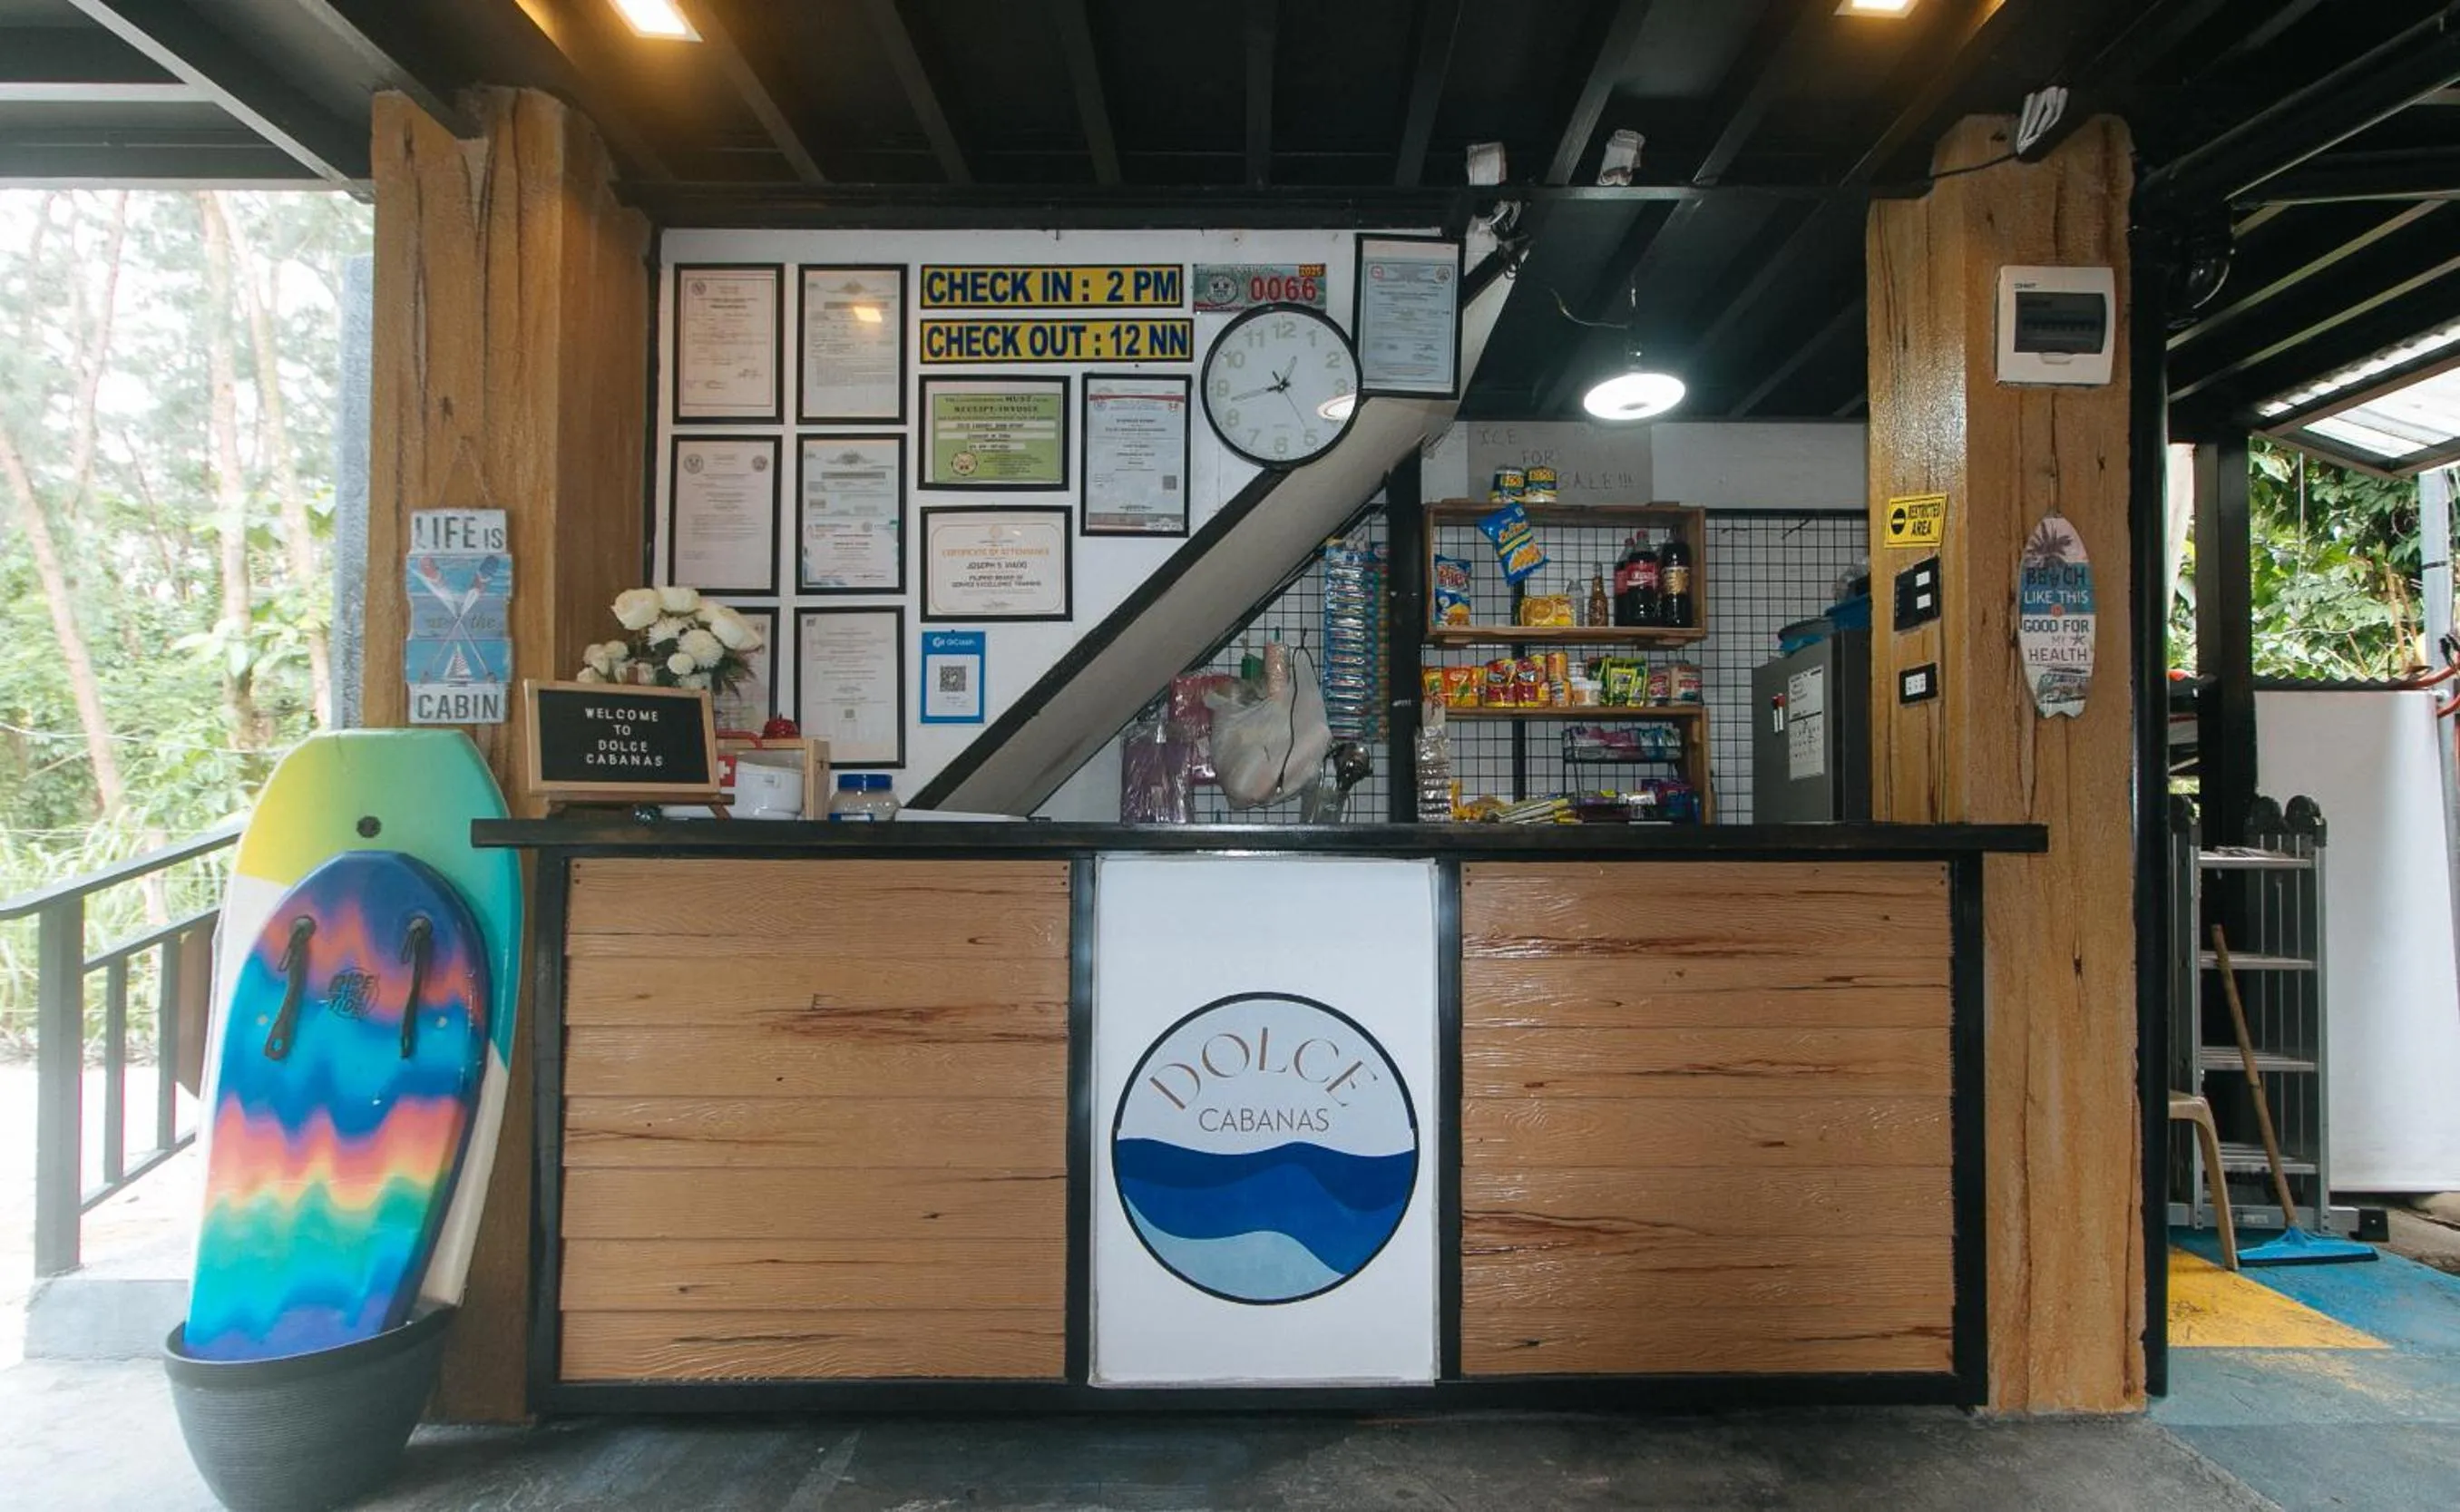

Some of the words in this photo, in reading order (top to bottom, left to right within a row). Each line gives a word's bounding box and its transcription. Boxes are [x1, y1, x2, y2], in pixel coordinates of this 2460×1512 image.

[927, 271, 1033, 303] CHECK
[1041, 271, 1072, 302] IN
[1107, 270, 1124, 302] 2
[1135, 270, 1176, 302] PM
[1249, 276, 1316, 301] 0066
[1244, 328, 1265, 348] 11
[1272, 320, 1297, 339] 12
[1306, 328, 1318, 347] 1
[927, 325, 1021, 357] CHECK
[1030, 325, 1087, 356] OUT
[1110, 324, 1140, 356] 12
[1149, 324, 1187, 356] NN
[1225, 351, 1245, 369] 10
[1325, 352, 1341, 368] 2
[1246, 429, 1261, 446] 7
[1479, 427, 1518, 445] ICE
[1521, 449, 1555, 465] FOR
[415, 515, 477, 550] LIFE
[483, 527, 504, 550] IS
[2025, 590, 2054, 605] LIKE
[2057, 590, 2090, 605] THIS
[2023, 619, 2059, 633] GOOD
[2062, 619, 2090, 633] FOR
[2028, 647, 2087, 662] HEALTH
[416, 693, 499, 720] CABIN
[584, 707, 659, 723] WELCOME
[613, 724, 631, 736] TO
[598, 739, 649, 754] DOLCE
[585, 753, 664, 767] CABANAS
[1148, 1026, 1379, 1111] DOLCE
[1198, 1107, 1331, 1133] CABANAS
